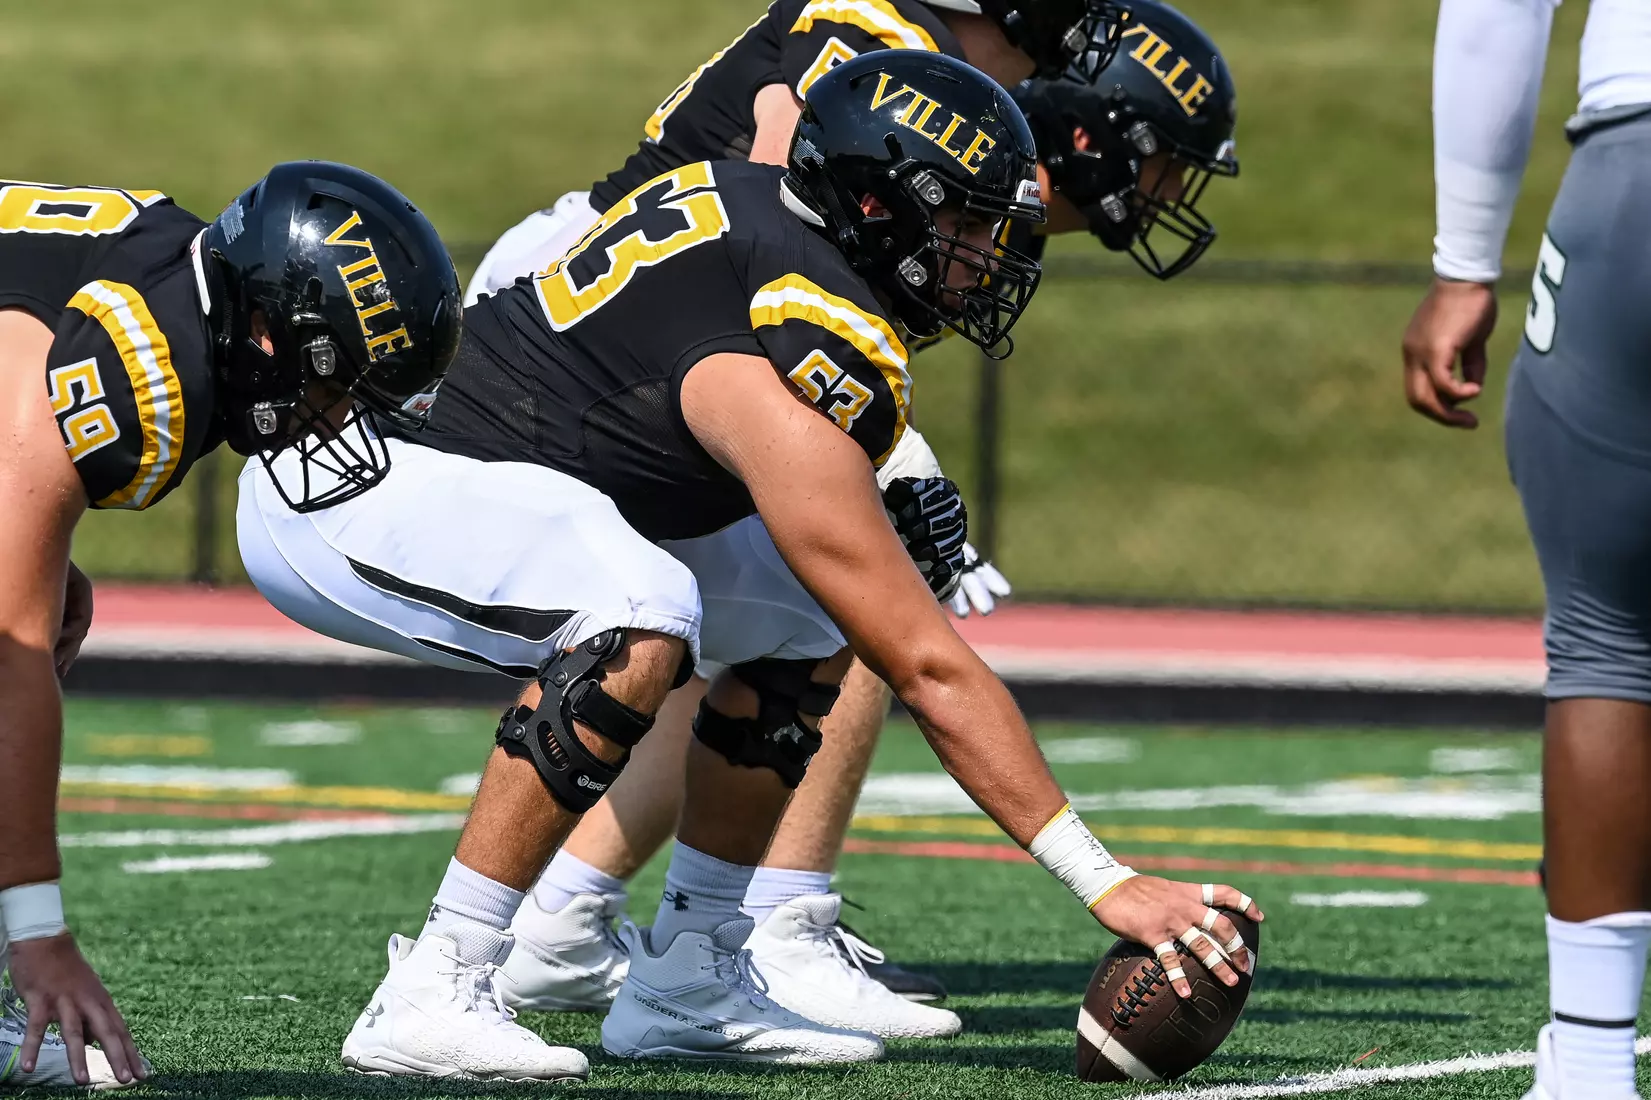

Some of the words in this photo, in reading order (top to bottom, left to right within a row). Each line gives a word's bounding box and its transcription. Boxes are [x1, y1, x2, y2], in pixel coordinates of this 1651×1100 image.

[1108, 11, 1214, 117] VILLE
[870, 72, 996, 175] VILLE
[323, 210, 413, 363] VILLE
[48, 356, 121, 463] 59
[787, 348, 875, 433] 63
[586, 781, 607, 792] BRE
[633, 993, 679, 1020] UNDER
[680, 1016, 744, 1039] ARMOUR
